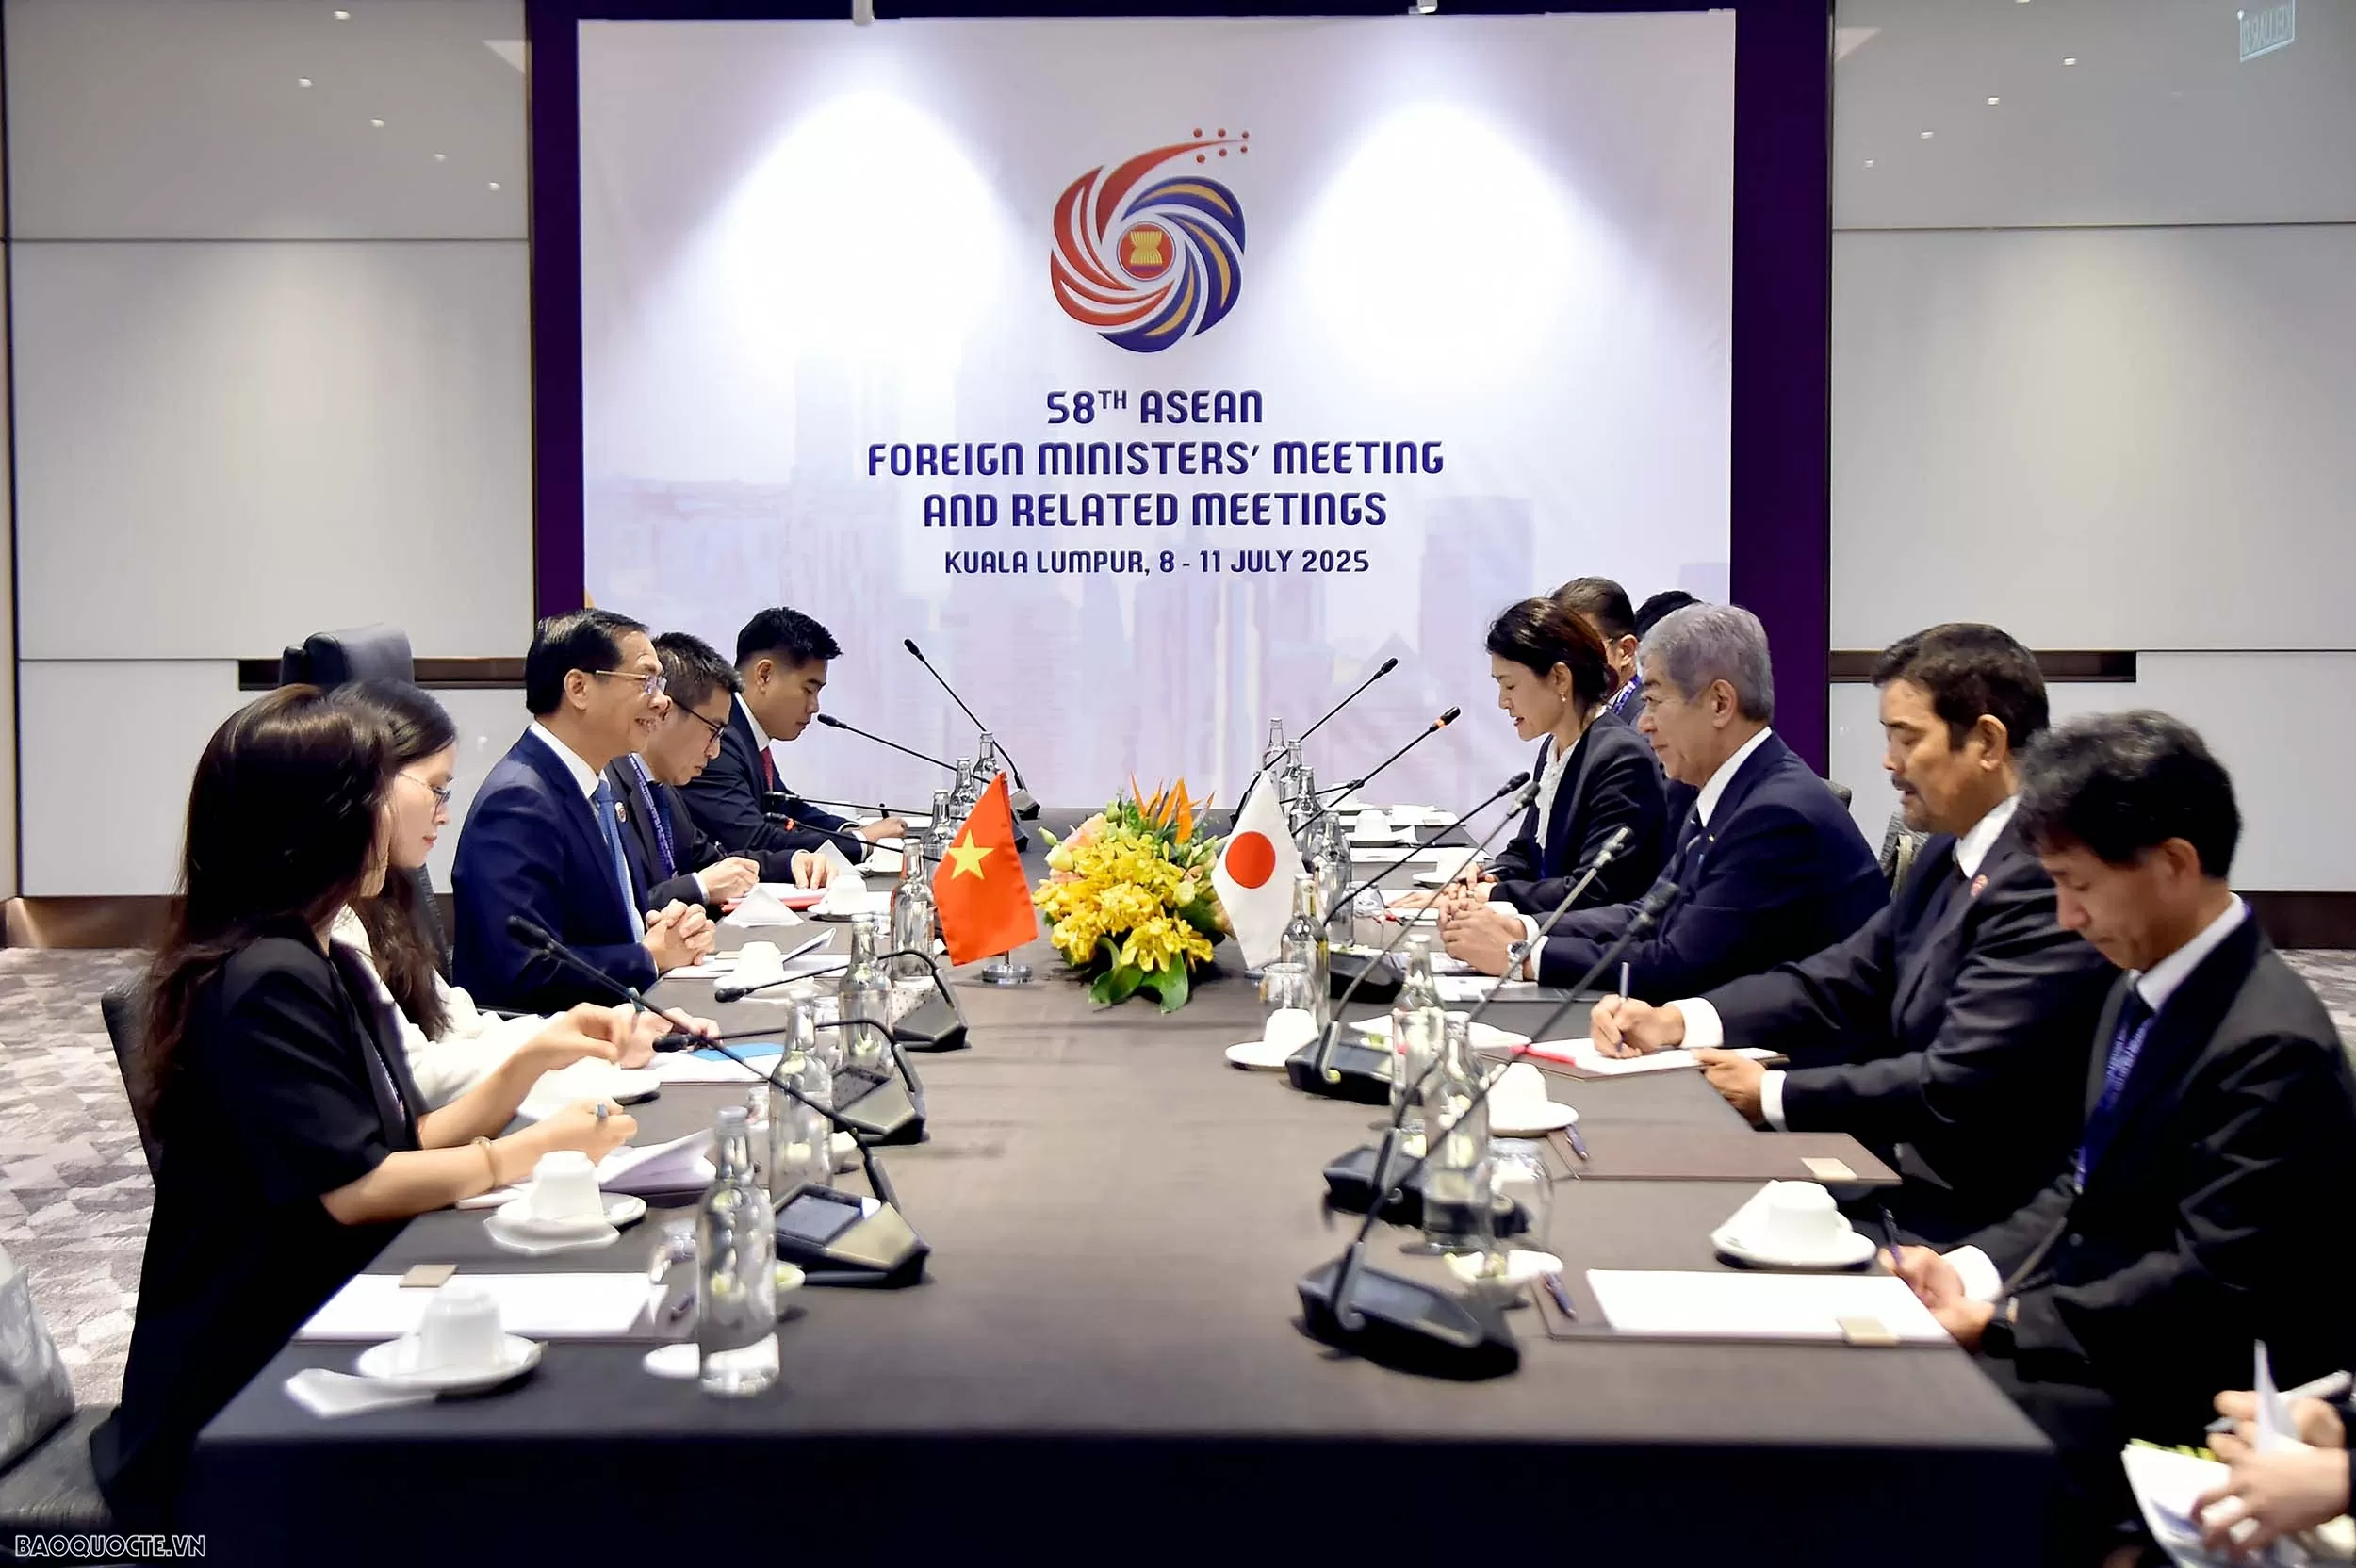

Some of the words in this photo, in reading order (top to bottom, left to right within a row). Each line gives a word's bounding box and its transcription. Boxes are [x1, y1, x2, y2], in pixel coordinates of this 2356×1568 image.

[1046, 389, 1127, 425] 58TH
[1140, 389, 1263, 424] ASEAN
[868, 442, 1023, 476] FOREIGN
[1273, 440, 1444, 475] MEETING
[924, 493, 998, 527] AND
[1012, 492, 1178, 527] RELATED
[1192, 492, 1387, 526] MEETINGS
[945, 550, 1028, 574] KUALA
[1037, 550, 1151, 577] LUMPUR,
[1159, 550, 1175, 573] 8
[1200, 549, 1220, 573] 11
[1230, 549, 1294, 573] JULY
[1301, 549, 1369, 573] 2025
